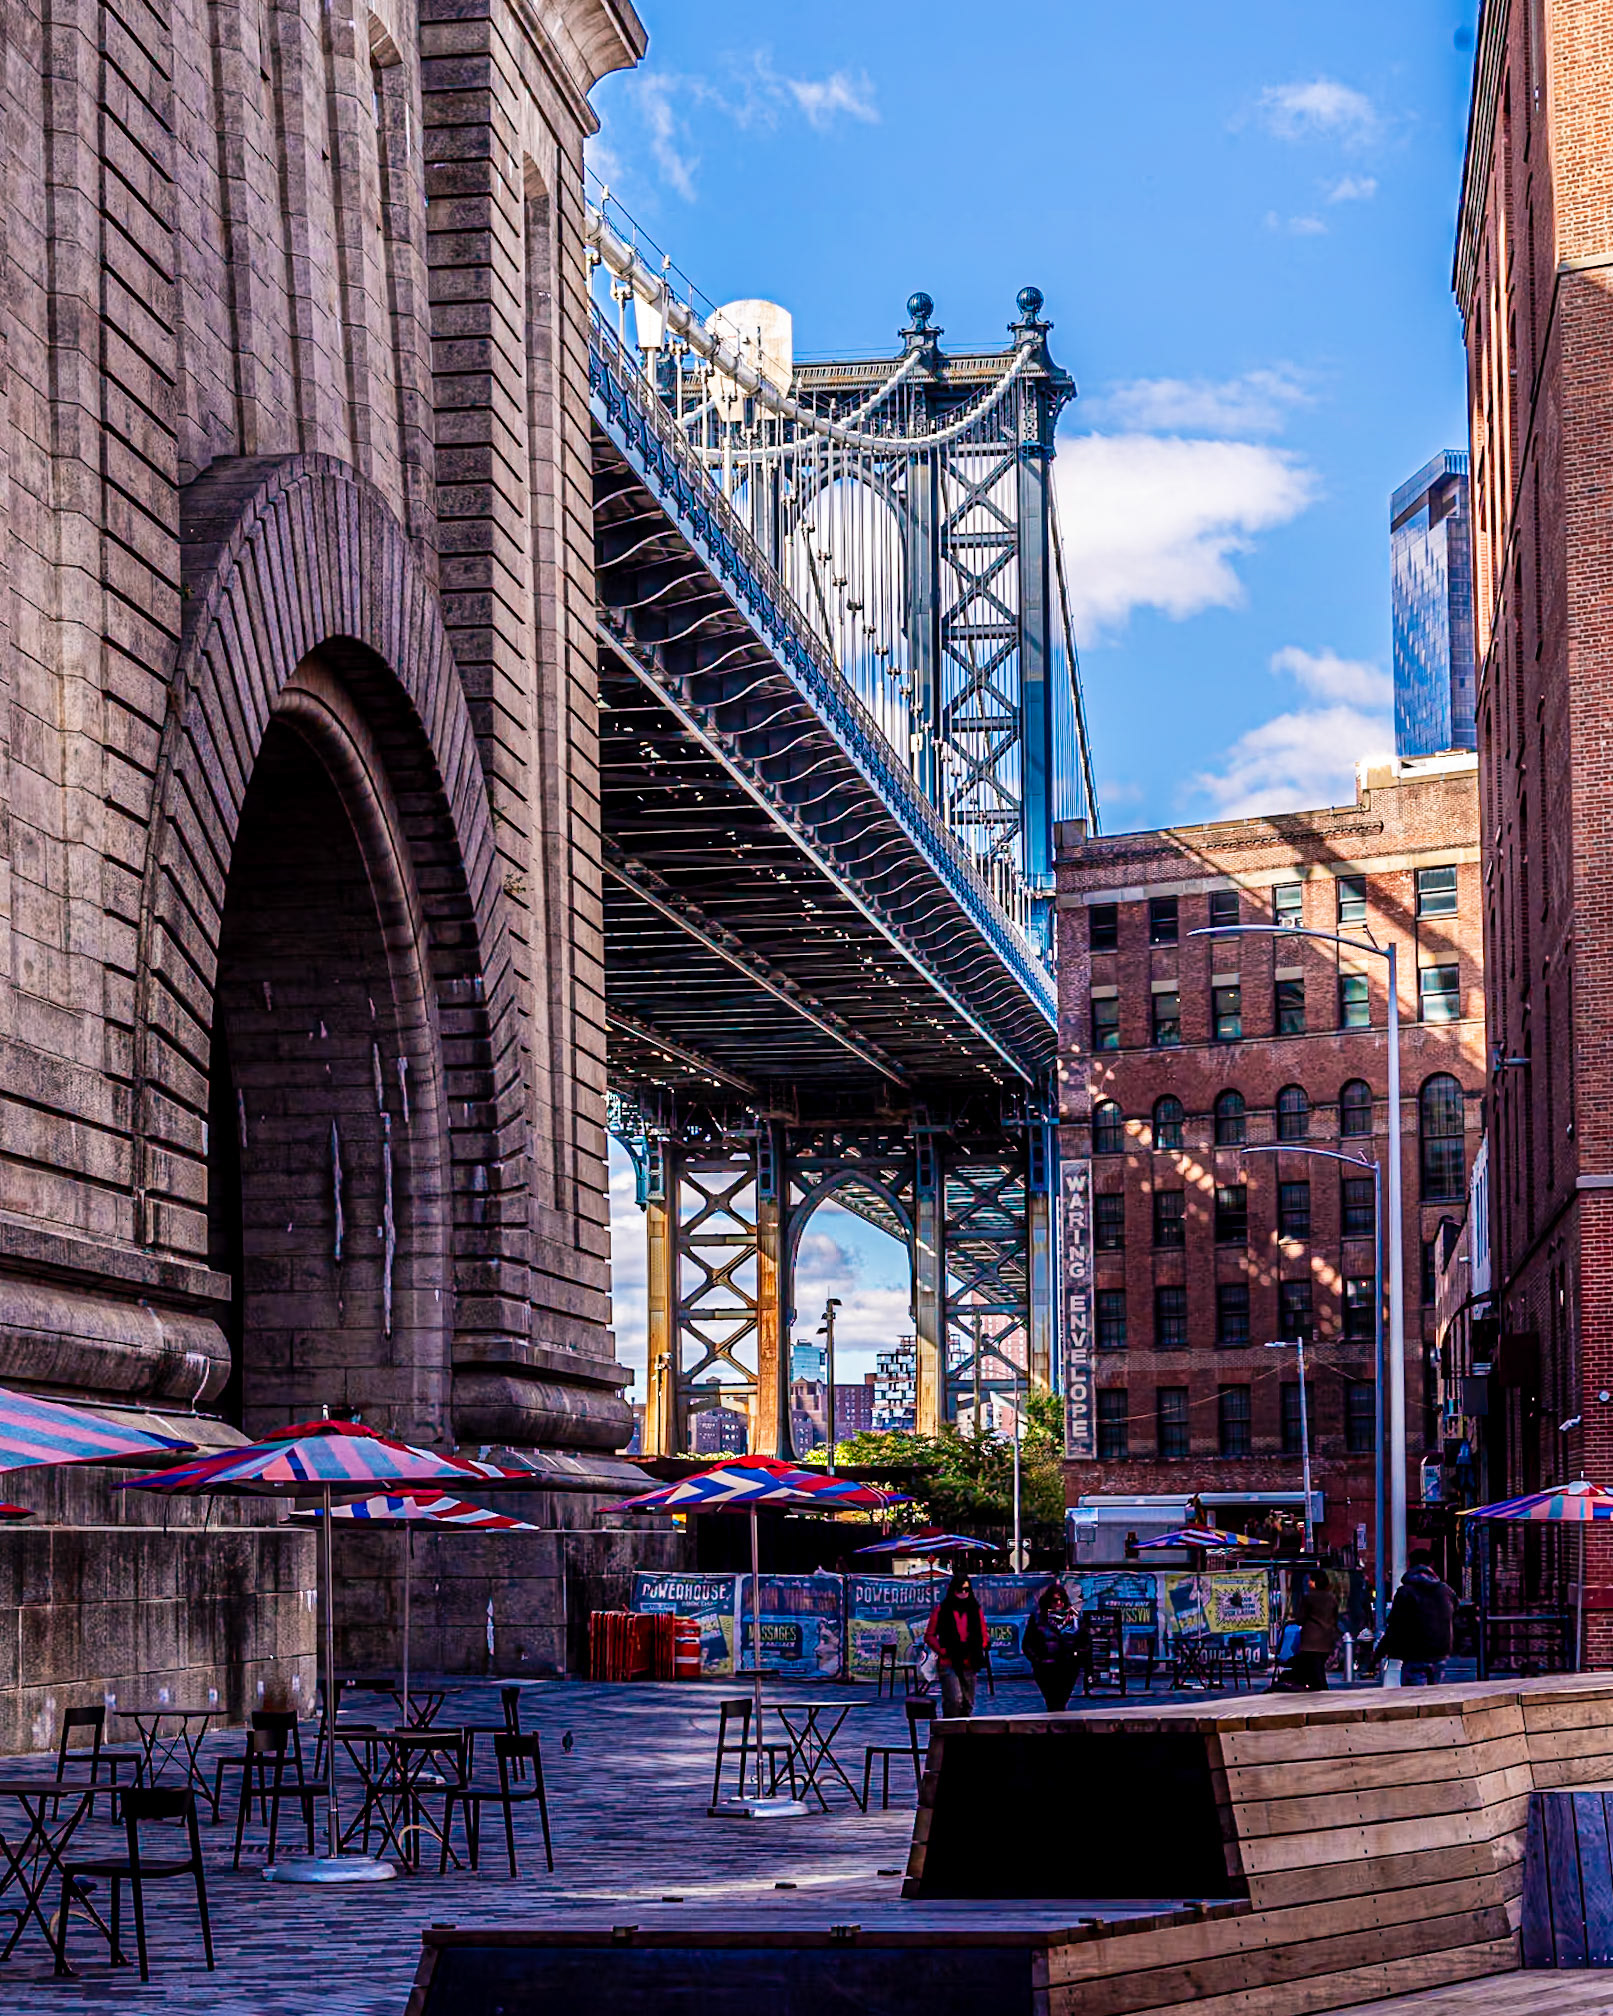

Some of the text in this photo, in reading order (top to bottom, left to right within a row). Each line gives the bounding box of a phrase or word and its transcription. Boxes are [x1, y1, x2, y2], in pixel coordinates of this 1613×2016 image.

[1066, 1176, 1088, 1437] WARING ENVELOPE
[642, 1583, 727, 1600] POWERHOUSE
[856, 1586, 940, 1604] POWERHOUSE
